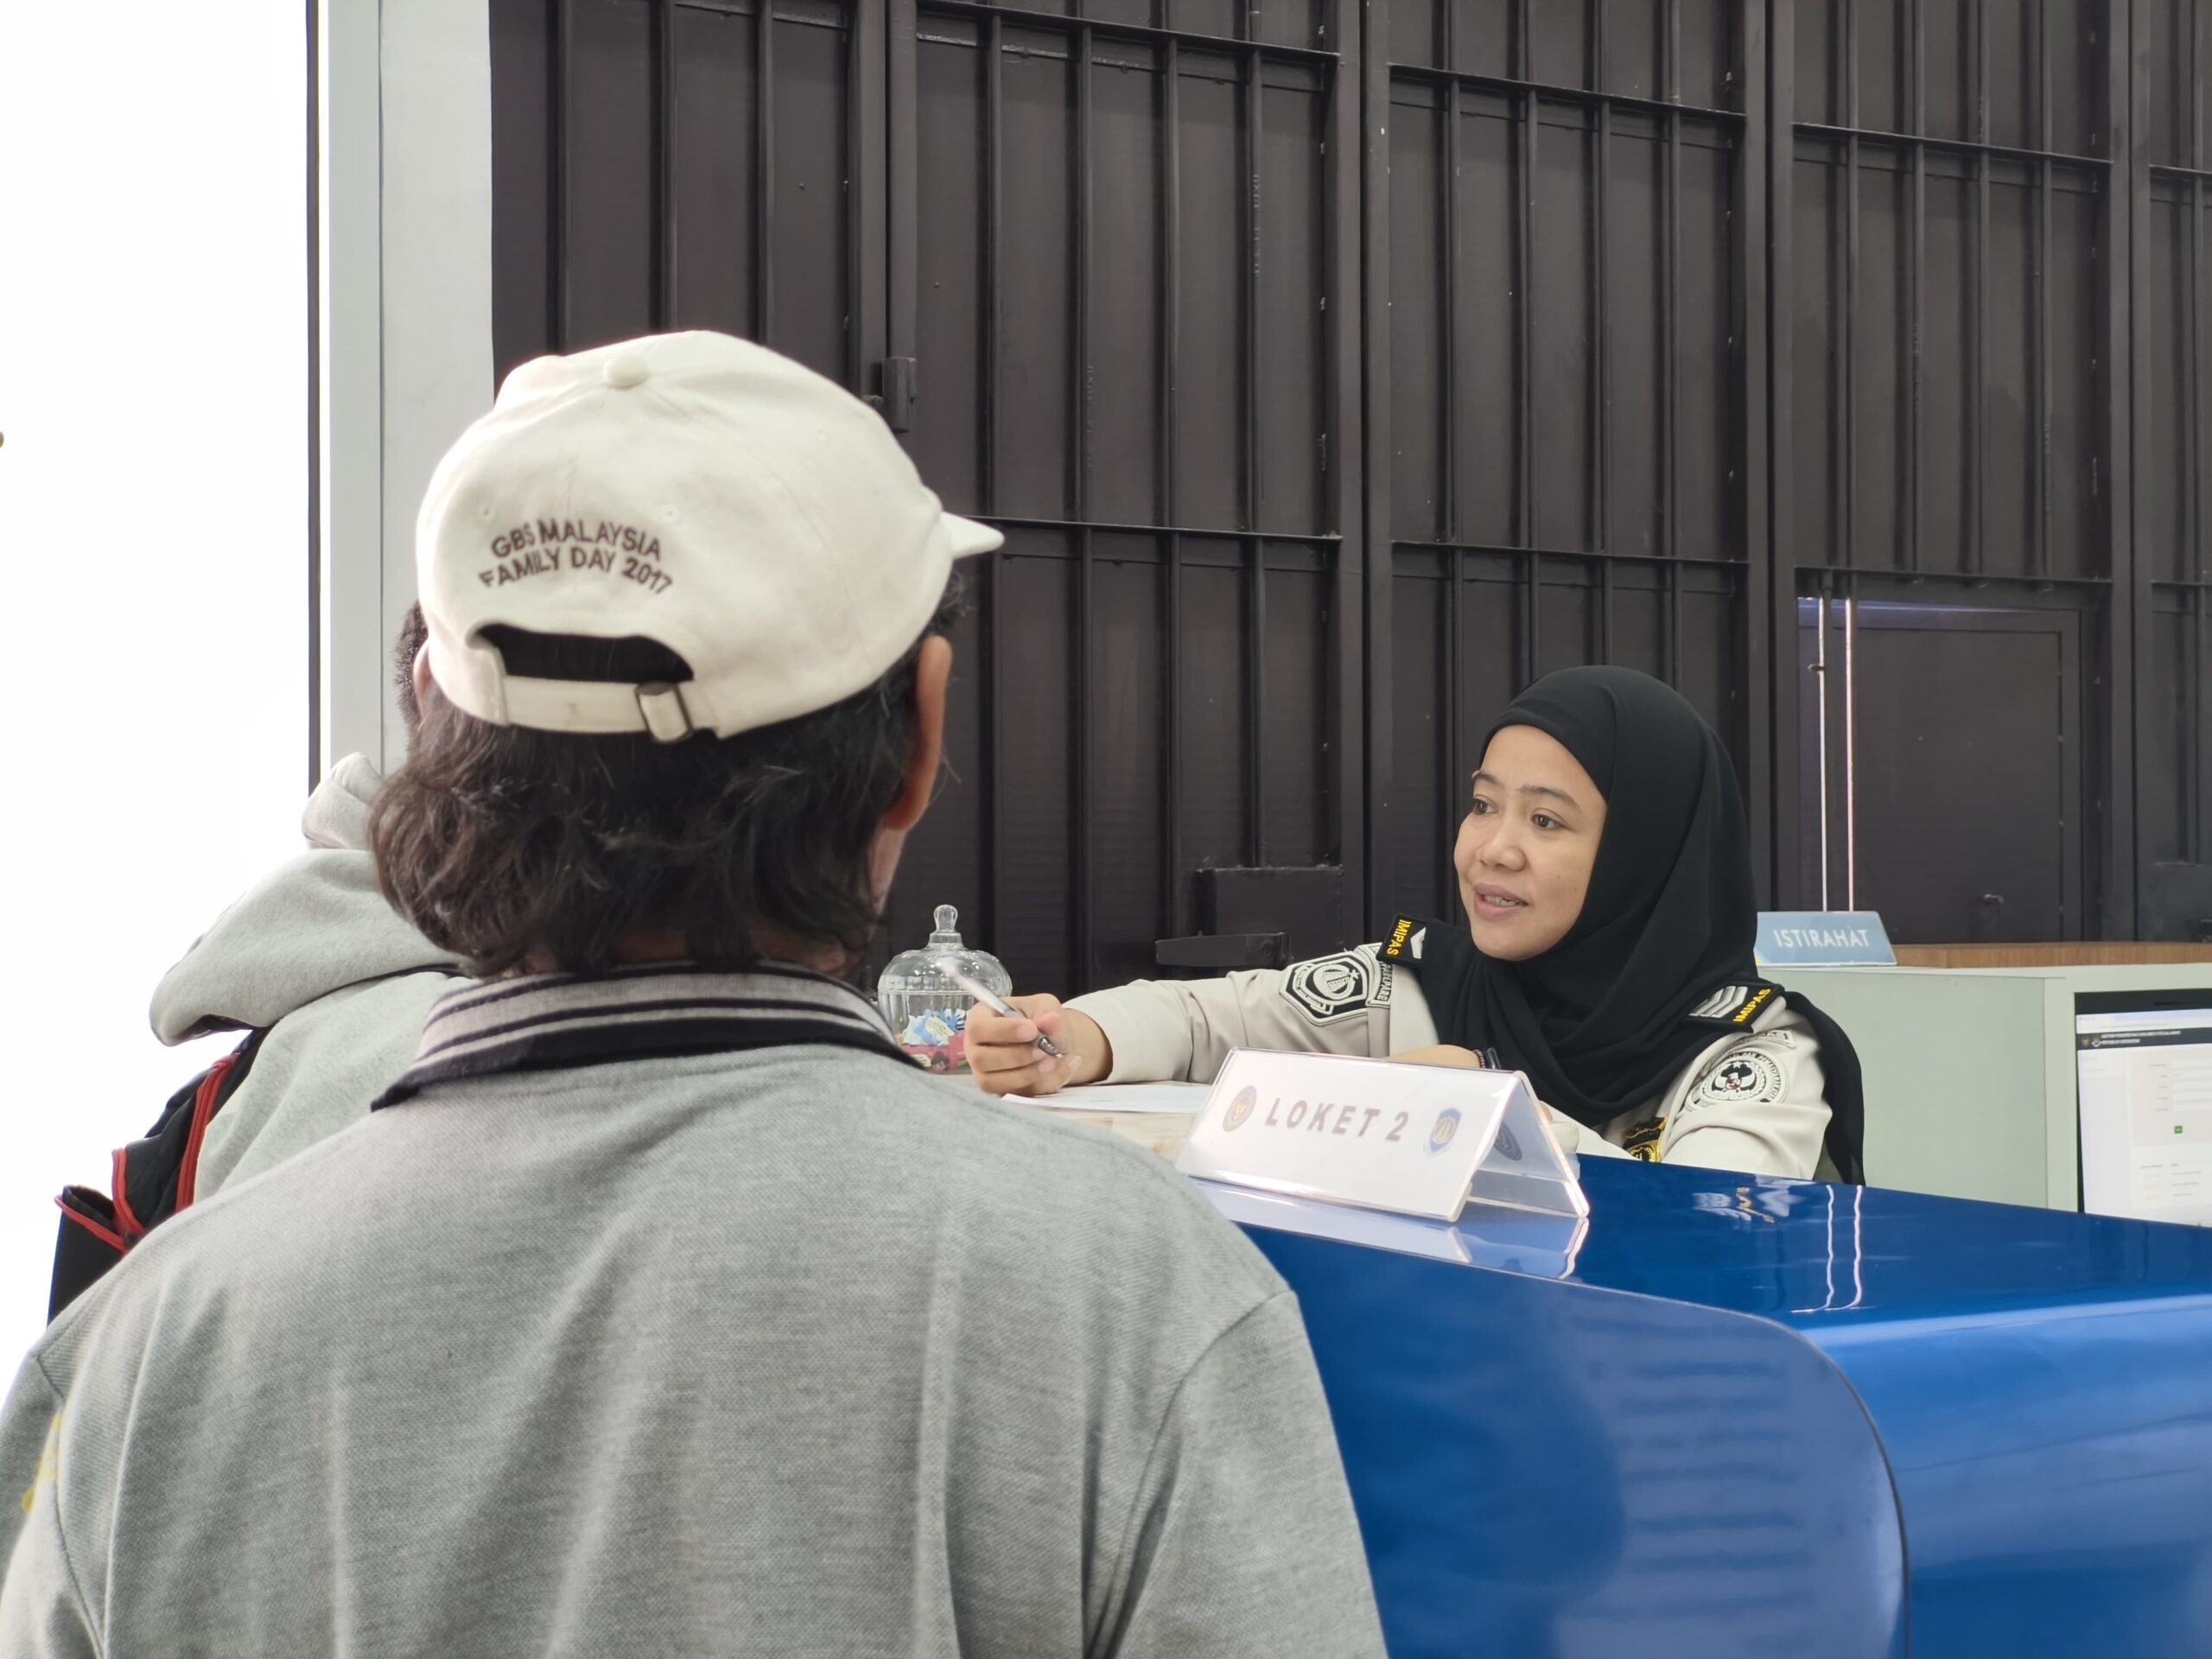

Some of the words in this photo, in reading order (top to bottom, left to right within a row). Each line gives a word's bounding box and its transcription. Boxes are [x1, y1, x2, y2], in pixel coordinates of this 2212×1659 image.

[491, 522, 536, 558] GBS
[537, 518, 661, 561] MALAYSIA
[479, 546, 561, 588] FAMILY
[570, 546, 616, 573] DAY
[621, 557, 672, 594] 2017
[1387, 918, 1412, 957] IMIPAS
[1773, 929, 1870, 948] ISTIRAHAT
[1732, 988, 1771, 1023] IMIPAS
[1264, 1097, 1381, 1137] LOKET
[1385, 1111, 1409, 1142] 2
